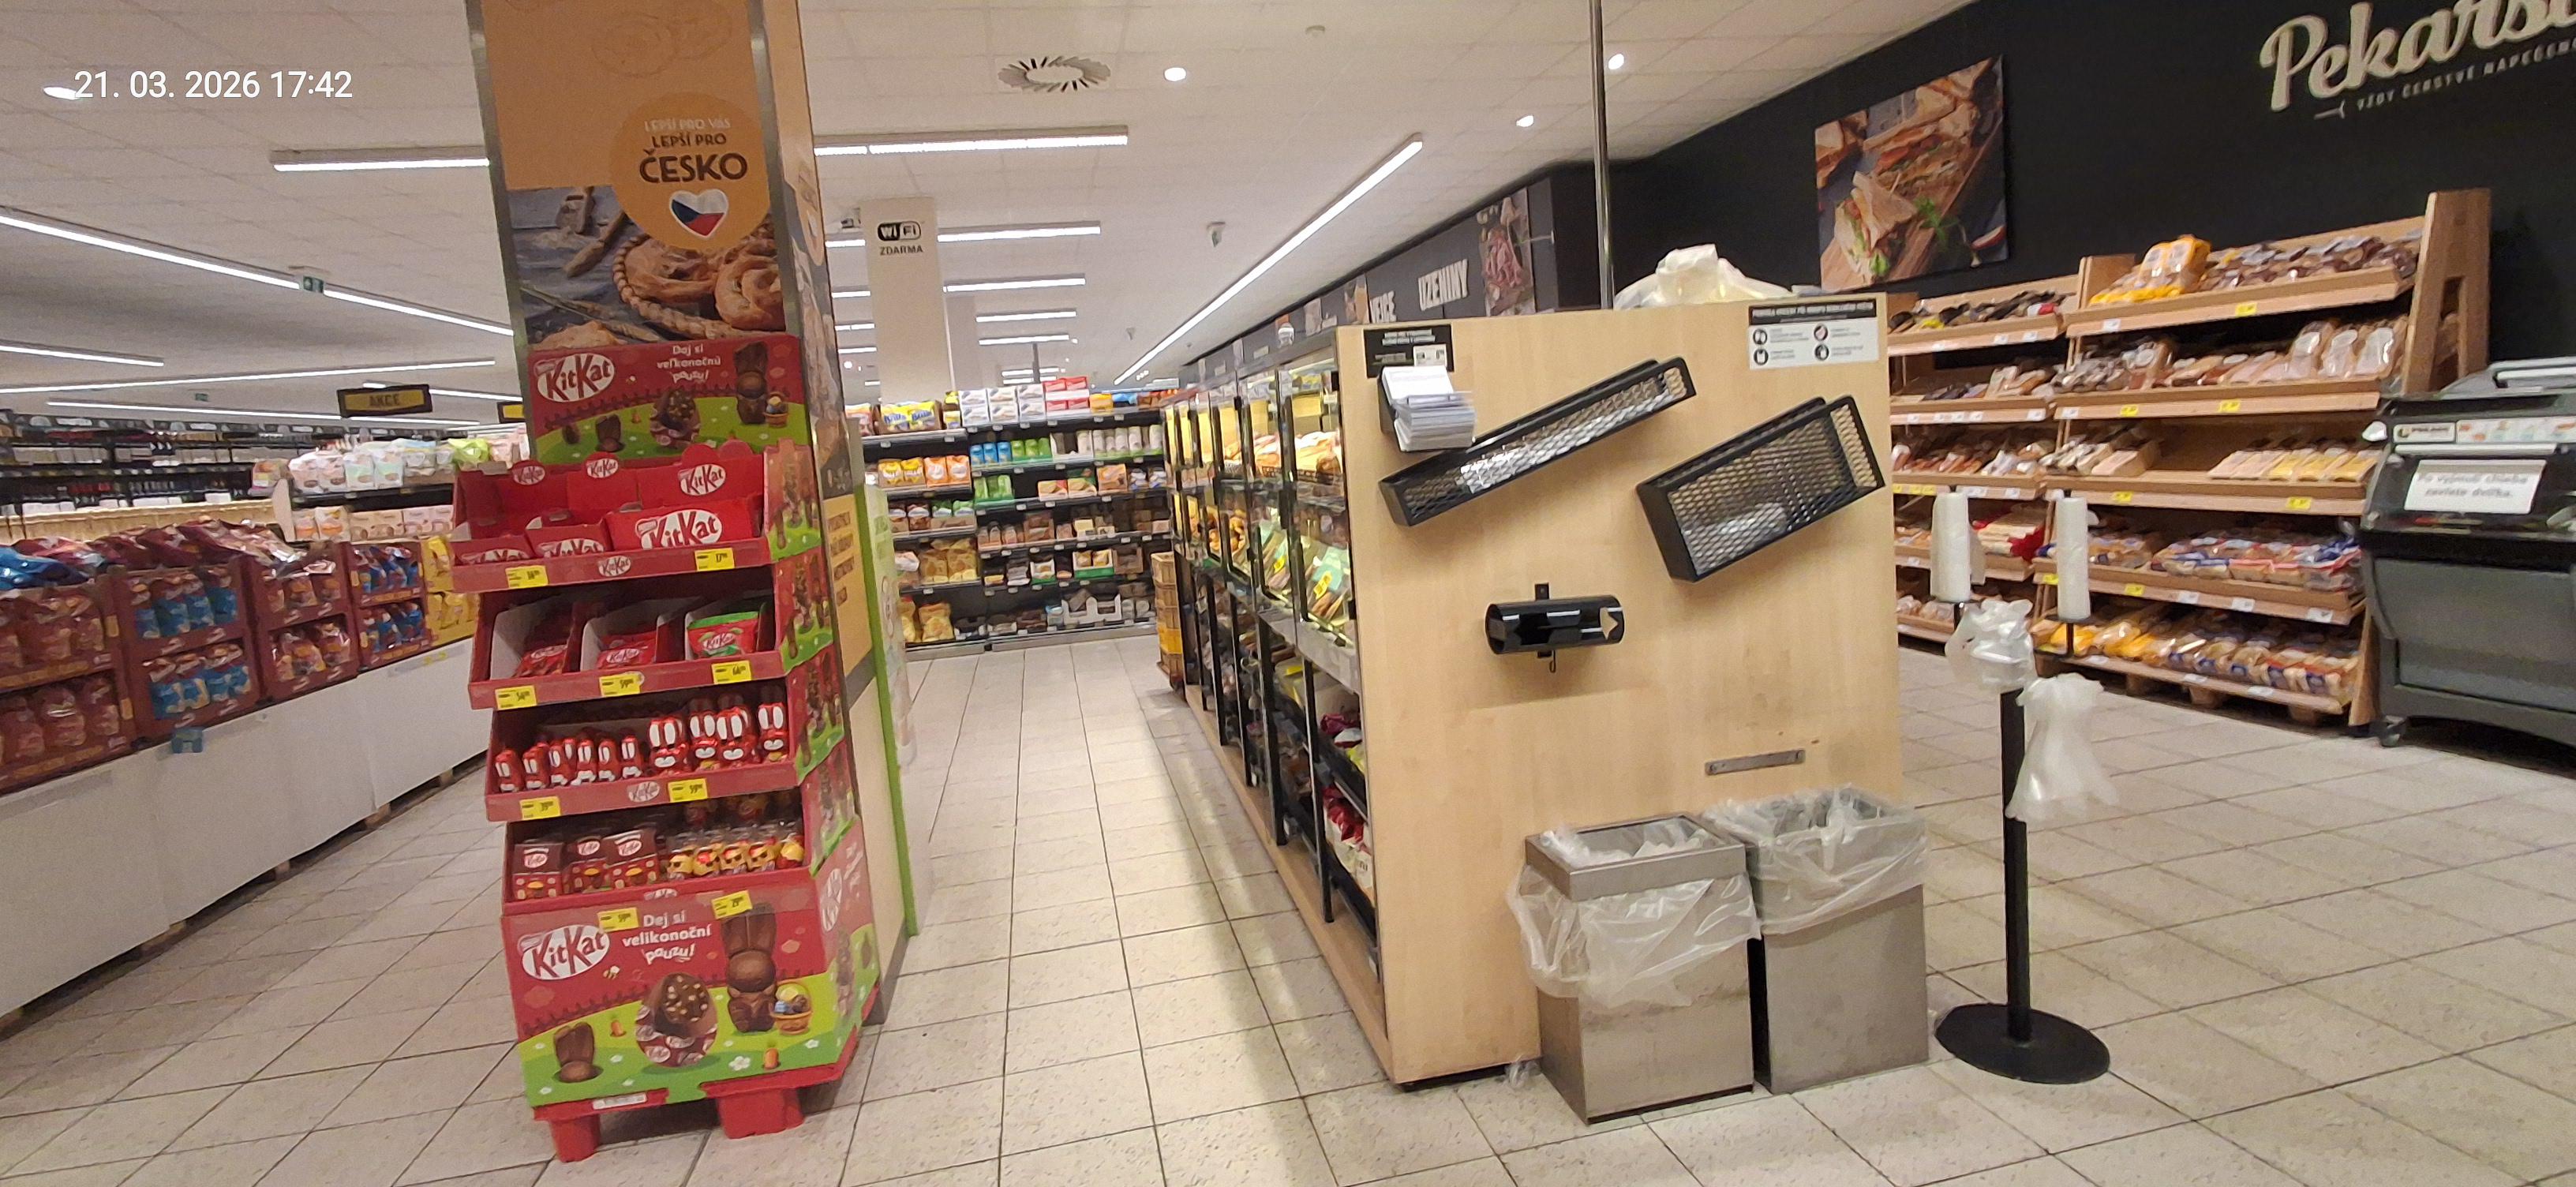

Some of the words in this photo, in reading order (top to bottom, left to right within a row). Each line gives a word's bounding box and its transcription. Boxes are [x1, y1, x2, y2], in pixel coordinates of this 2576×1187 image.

[652, 132, 691, 148] LEPŠÍ
[695, 133, 727, 146] PRO
[639, 148, 748, 184] ČESKO
[880, 245, 923, 256] ZDARMA
[1418, 259, 1468, 311] UZENINY
[544, 353, 613, 402] KitKat
[685, 465, 724, 495] KitKat
[643, 912, 668, 929] Dej
[672, 910, 686, 924] si
[622, 923, 712, 947] velikonoční
[531, 926, 605, 979] KitKat
